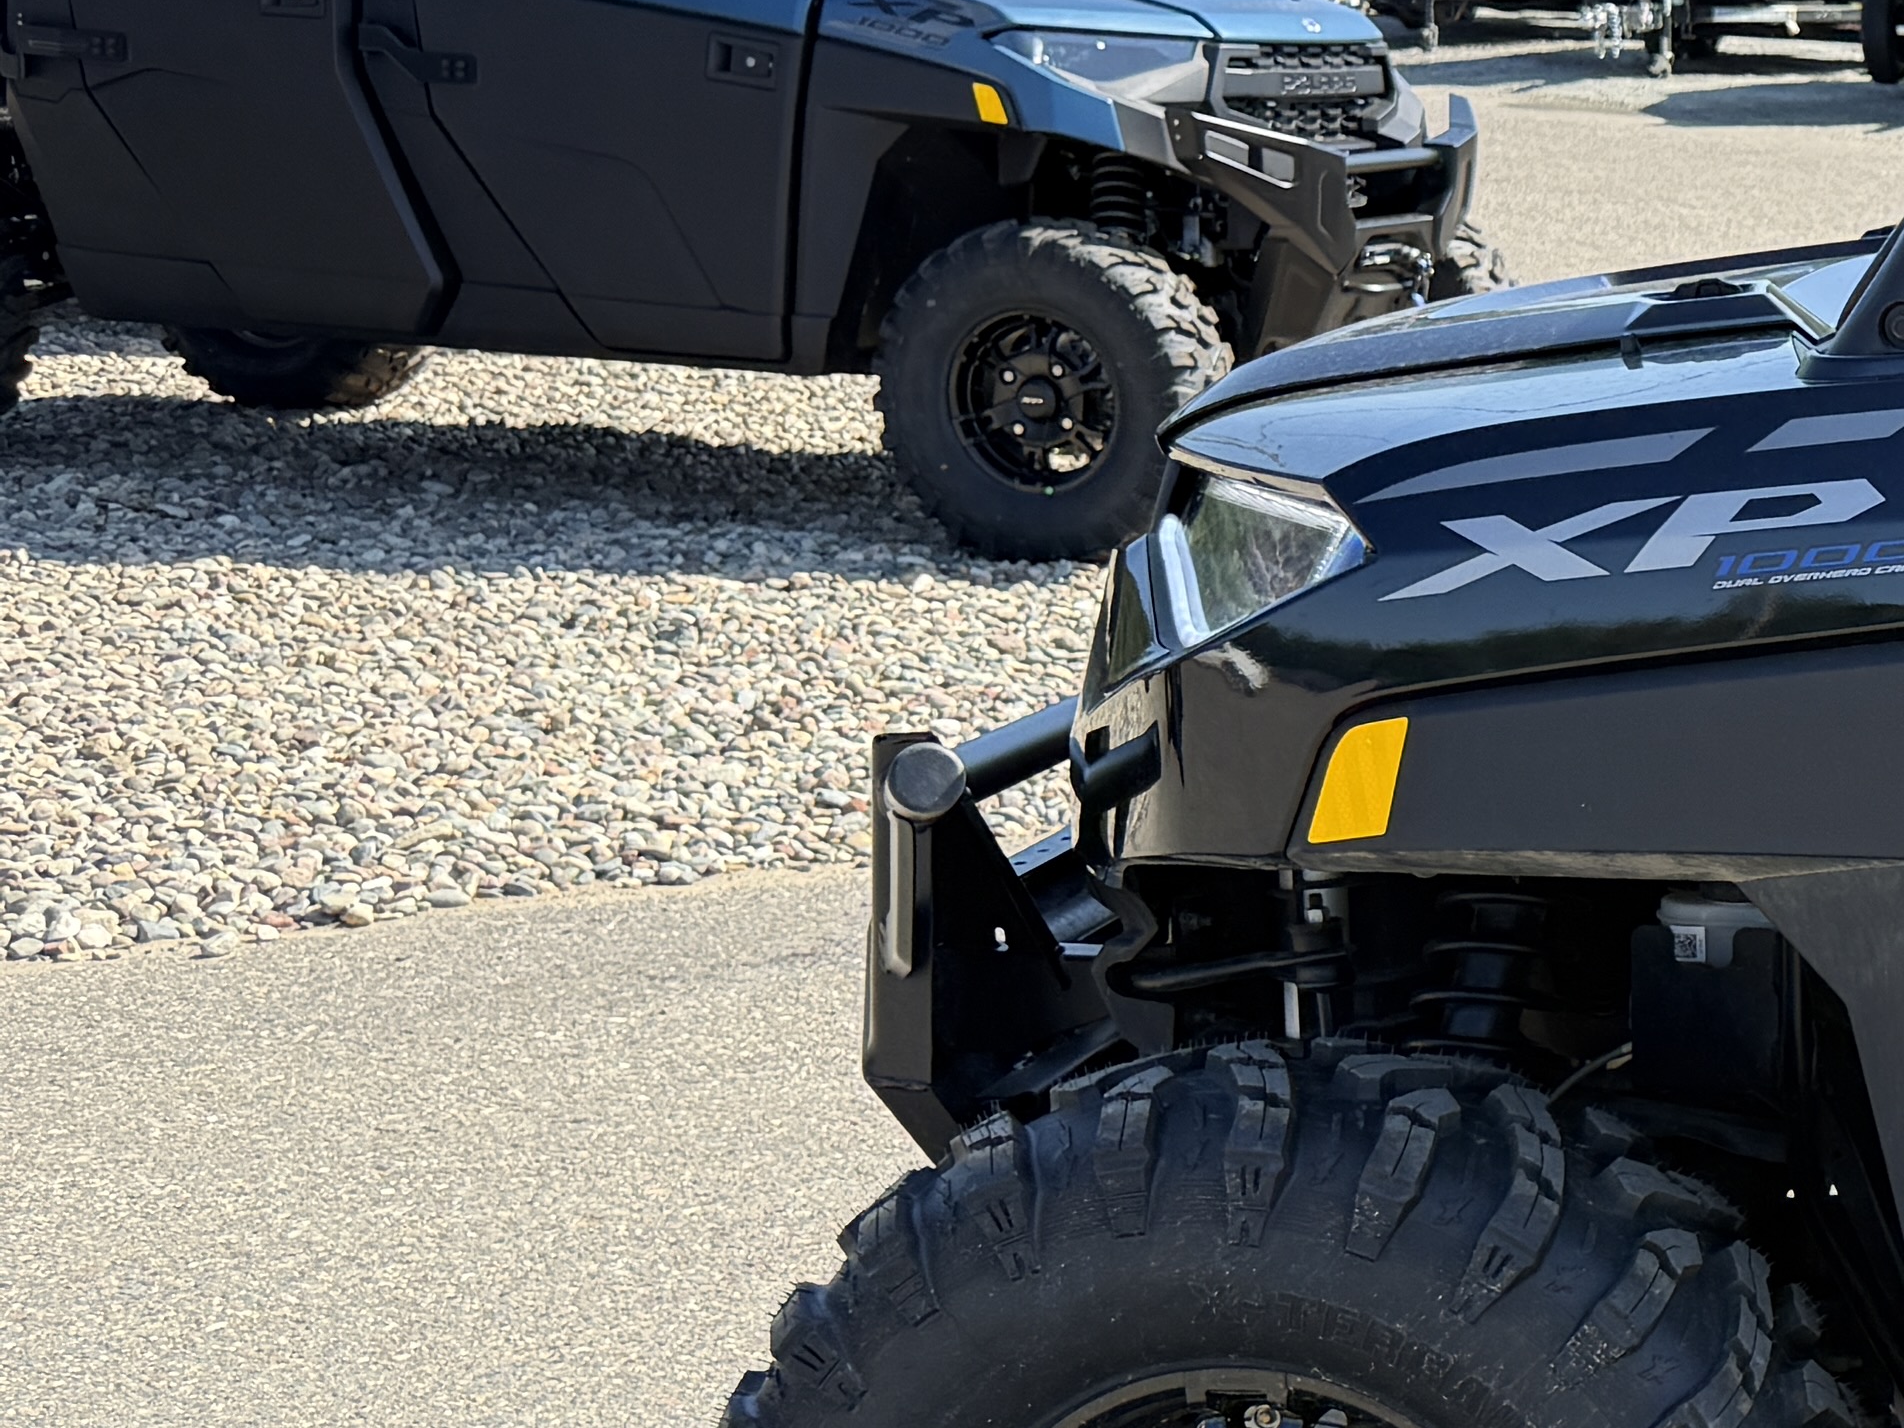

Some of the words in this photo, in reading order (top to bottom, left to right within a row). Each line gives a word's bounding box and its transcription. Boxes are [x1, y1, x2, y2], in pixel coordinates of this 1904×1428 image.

[858, 16, 950, 46] 1000
[1378, 477, 1887, 602] XP
[1712, 578, 1765, 591] DUAL
[1768, 566, 1872, 585] OVERHEAD
